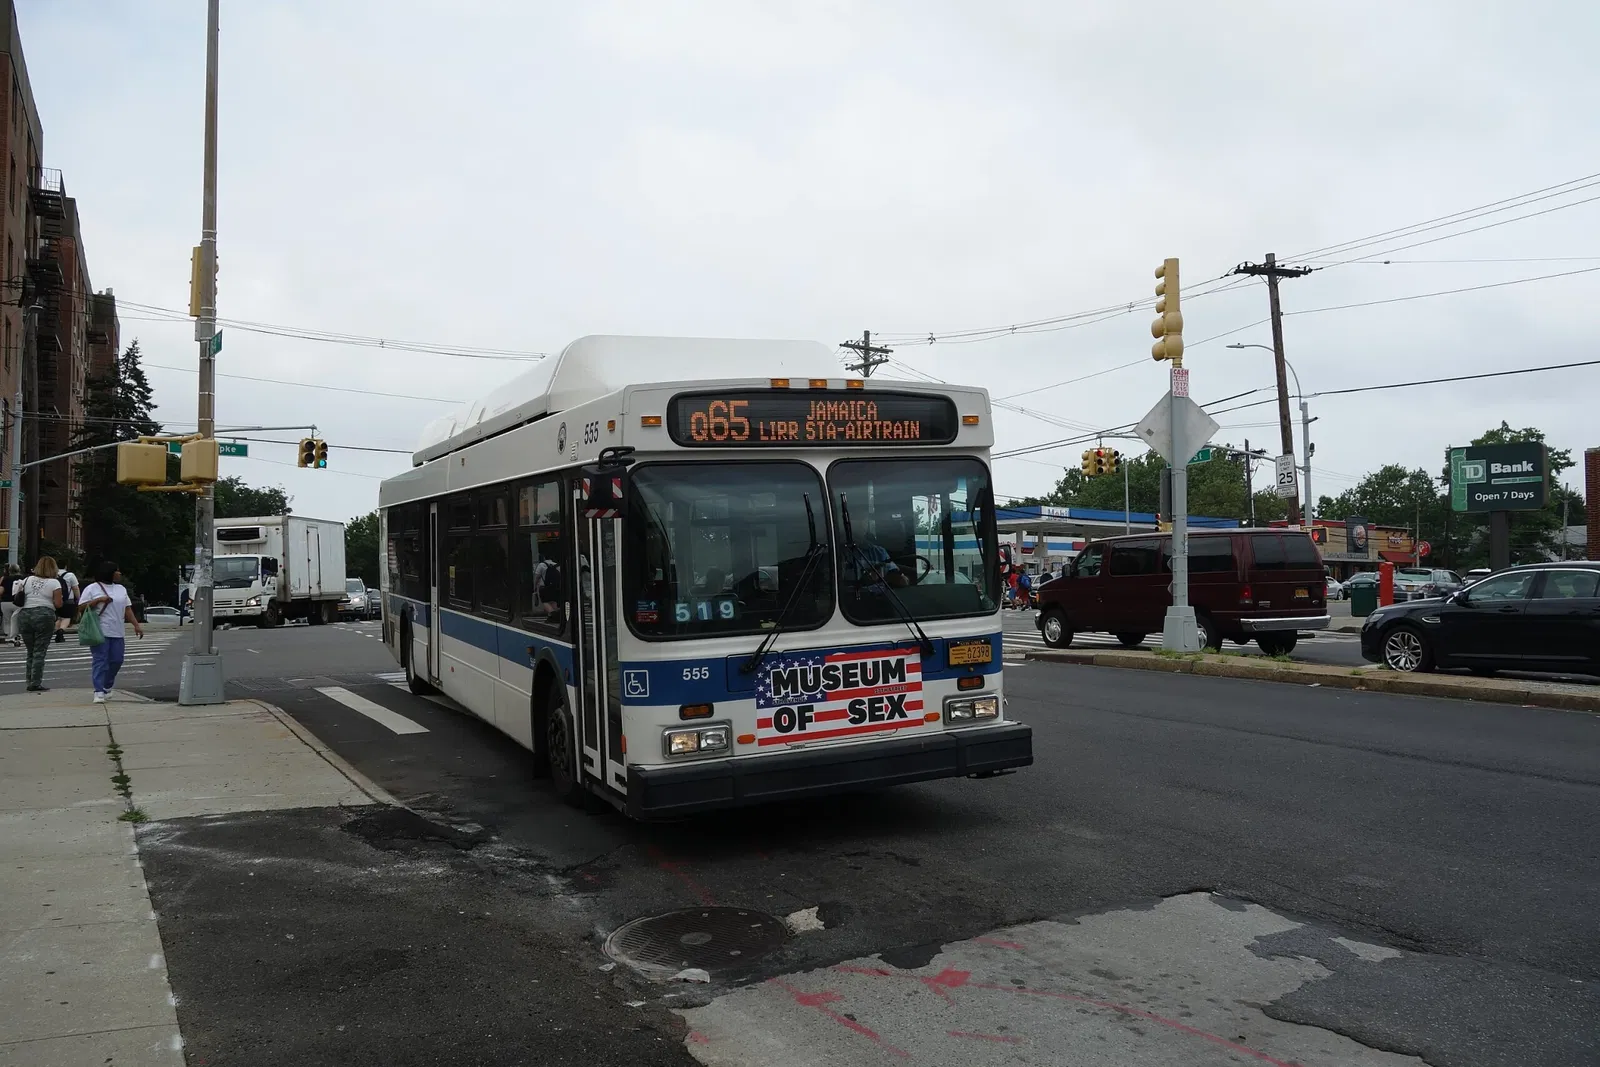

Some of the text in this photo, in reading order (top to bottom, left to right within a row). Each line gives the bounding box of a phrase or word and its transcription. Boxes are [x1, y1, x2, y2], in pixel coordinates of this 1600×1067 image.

[806, 400, 878, 420] JAMAICA
[690, 400, 750, 441] Q65
[760, 420, 920, 440] LIRR STA-AIRTRAIN
[584, 420, 599, 445] 555
[219, 444, 236, 454] pke
[1279, 472, 1293, 484] 25
[1462, 460, 1534, 478] TD Bank
[1474, 492, 1500, 502] Open
[1511, 491, 1534, 500] Days
[682, 666, 710, 680] 555
[772, 658, 906, 698] MUSEUM
[773, 694, 908, 734] OF SEX
